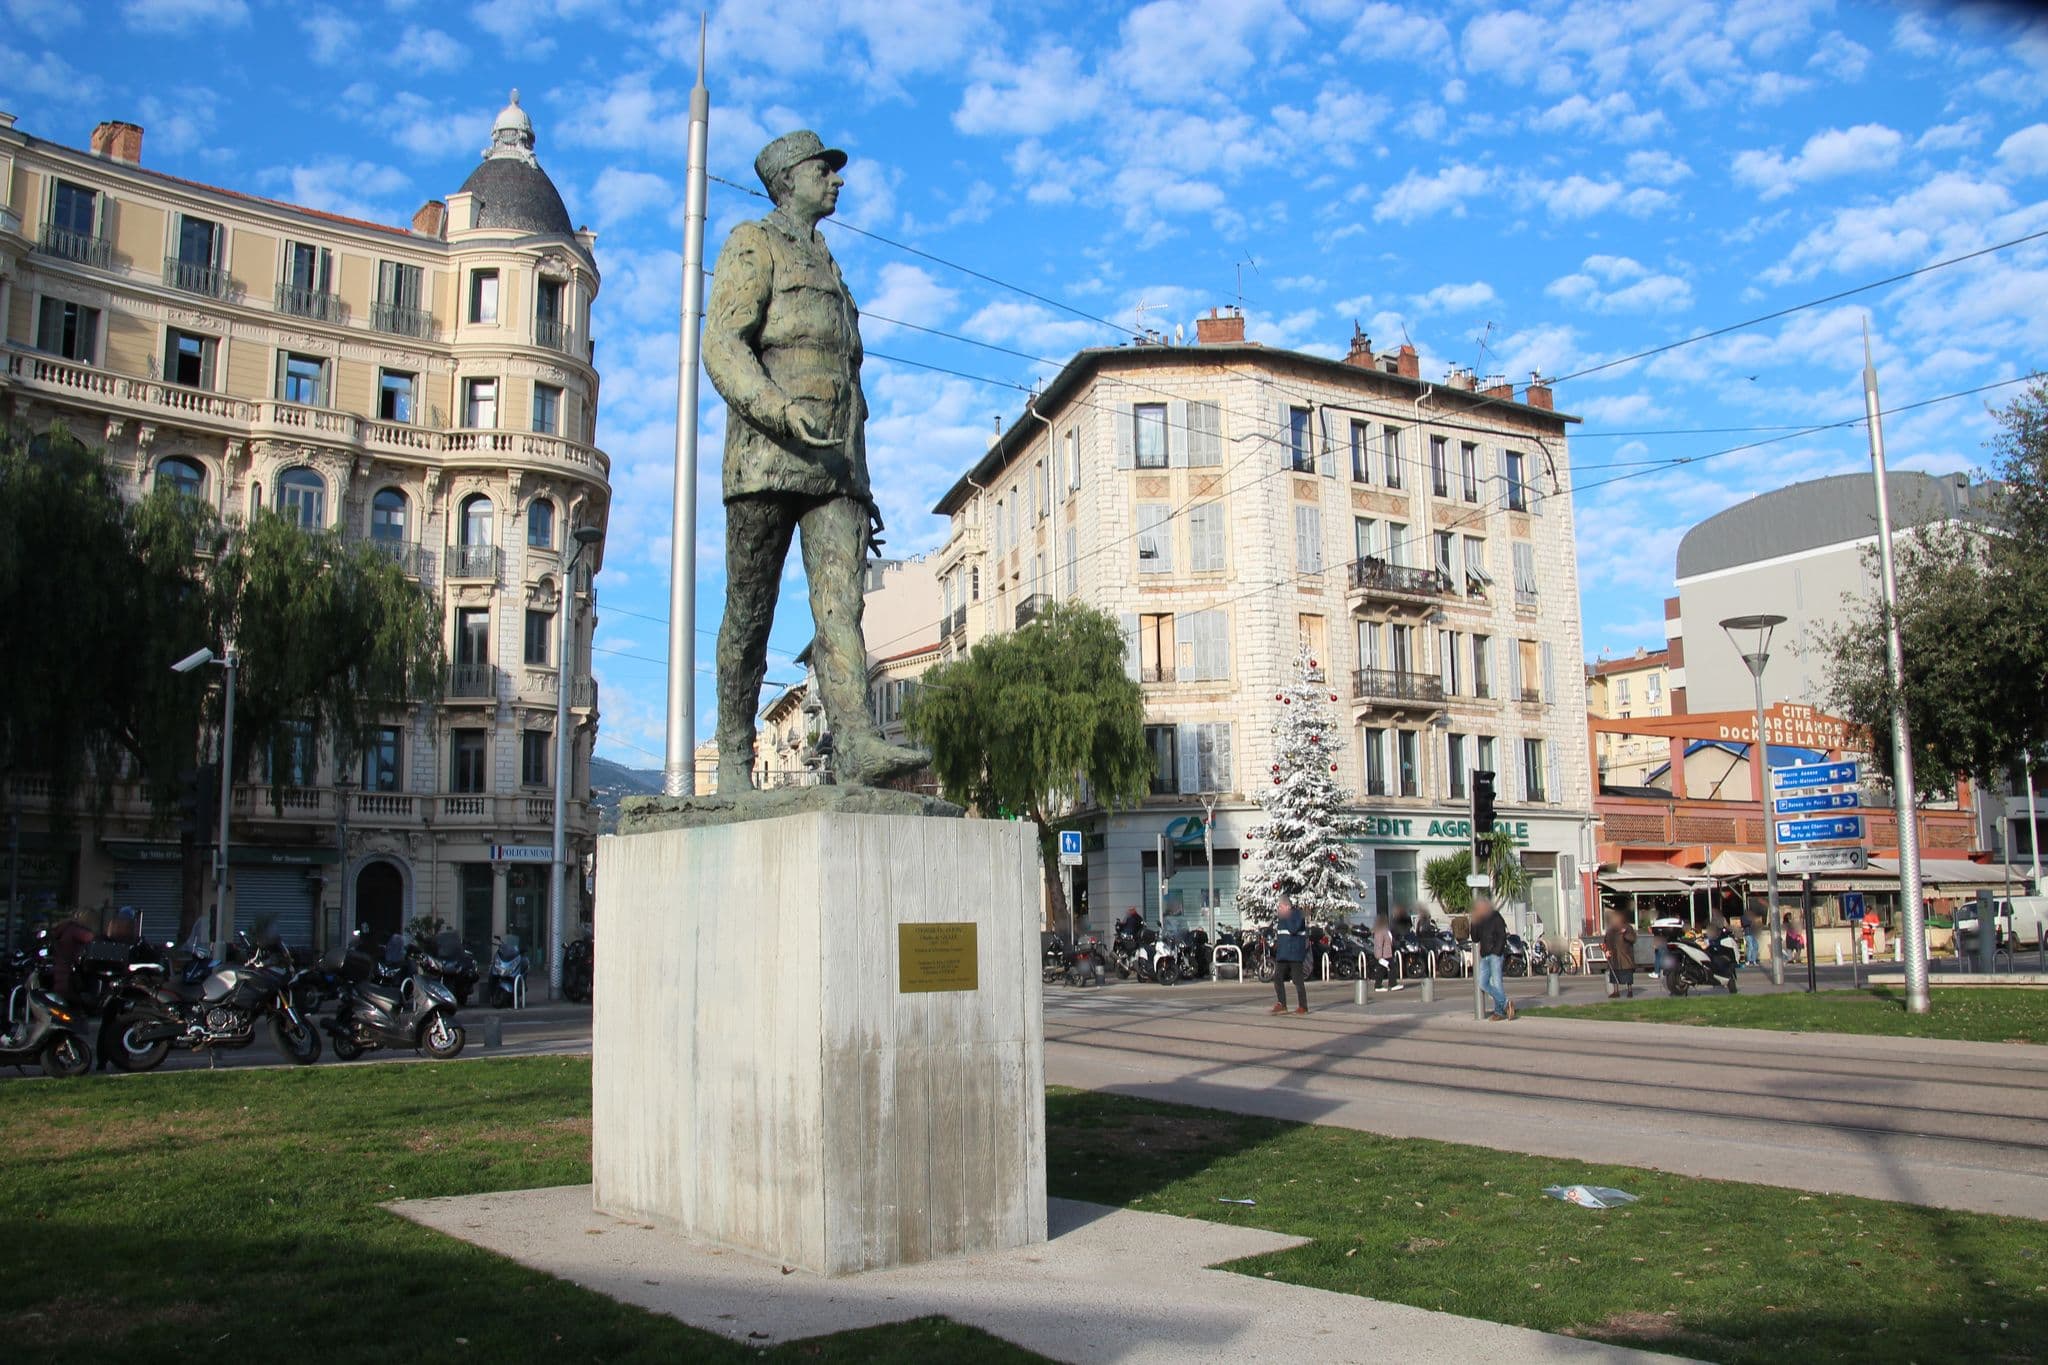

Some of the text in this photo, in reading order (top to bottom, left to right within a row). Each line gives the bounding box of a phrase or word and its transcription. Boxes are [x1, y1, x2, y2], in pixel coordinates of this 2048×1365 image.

[1782, 705, 1811, 720] CITE
[1720, 725, 1871, 752] DOCKS DE LA RIVI
[1426, 819, 1529, 838] AGROLE
[502, 847, 528, 857] POLICE
